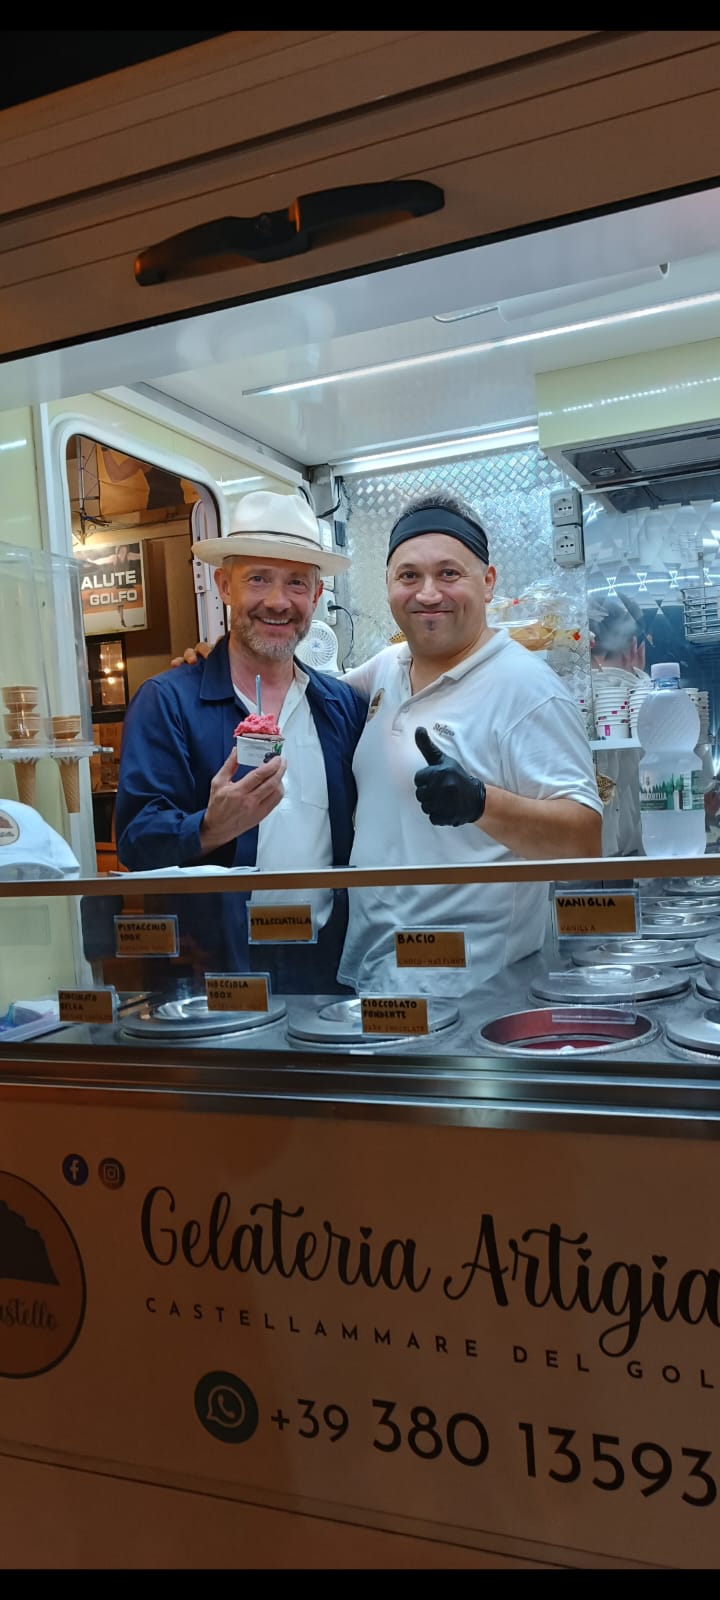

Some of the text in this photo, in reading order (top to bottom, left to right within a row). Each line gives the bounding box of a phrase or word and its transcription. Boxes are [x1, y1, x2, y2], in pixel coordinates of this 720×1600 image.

[81, 570, 136, 590] ALUTE
[90, 590, 137, 606] GOLFO
[557, 897, 616, 907] VANIGLIA
[397, 933, 436, 945] BACIO
[362, 999, 417, 1009] CIOCCOLATO
[140, 1185, 720, 1358] Gelateria Artigia
[145, 1297, 715, 1389] CASTELLAMMARE DEL GOL
[270, 1398, 718, 1508] +39 380 13593
